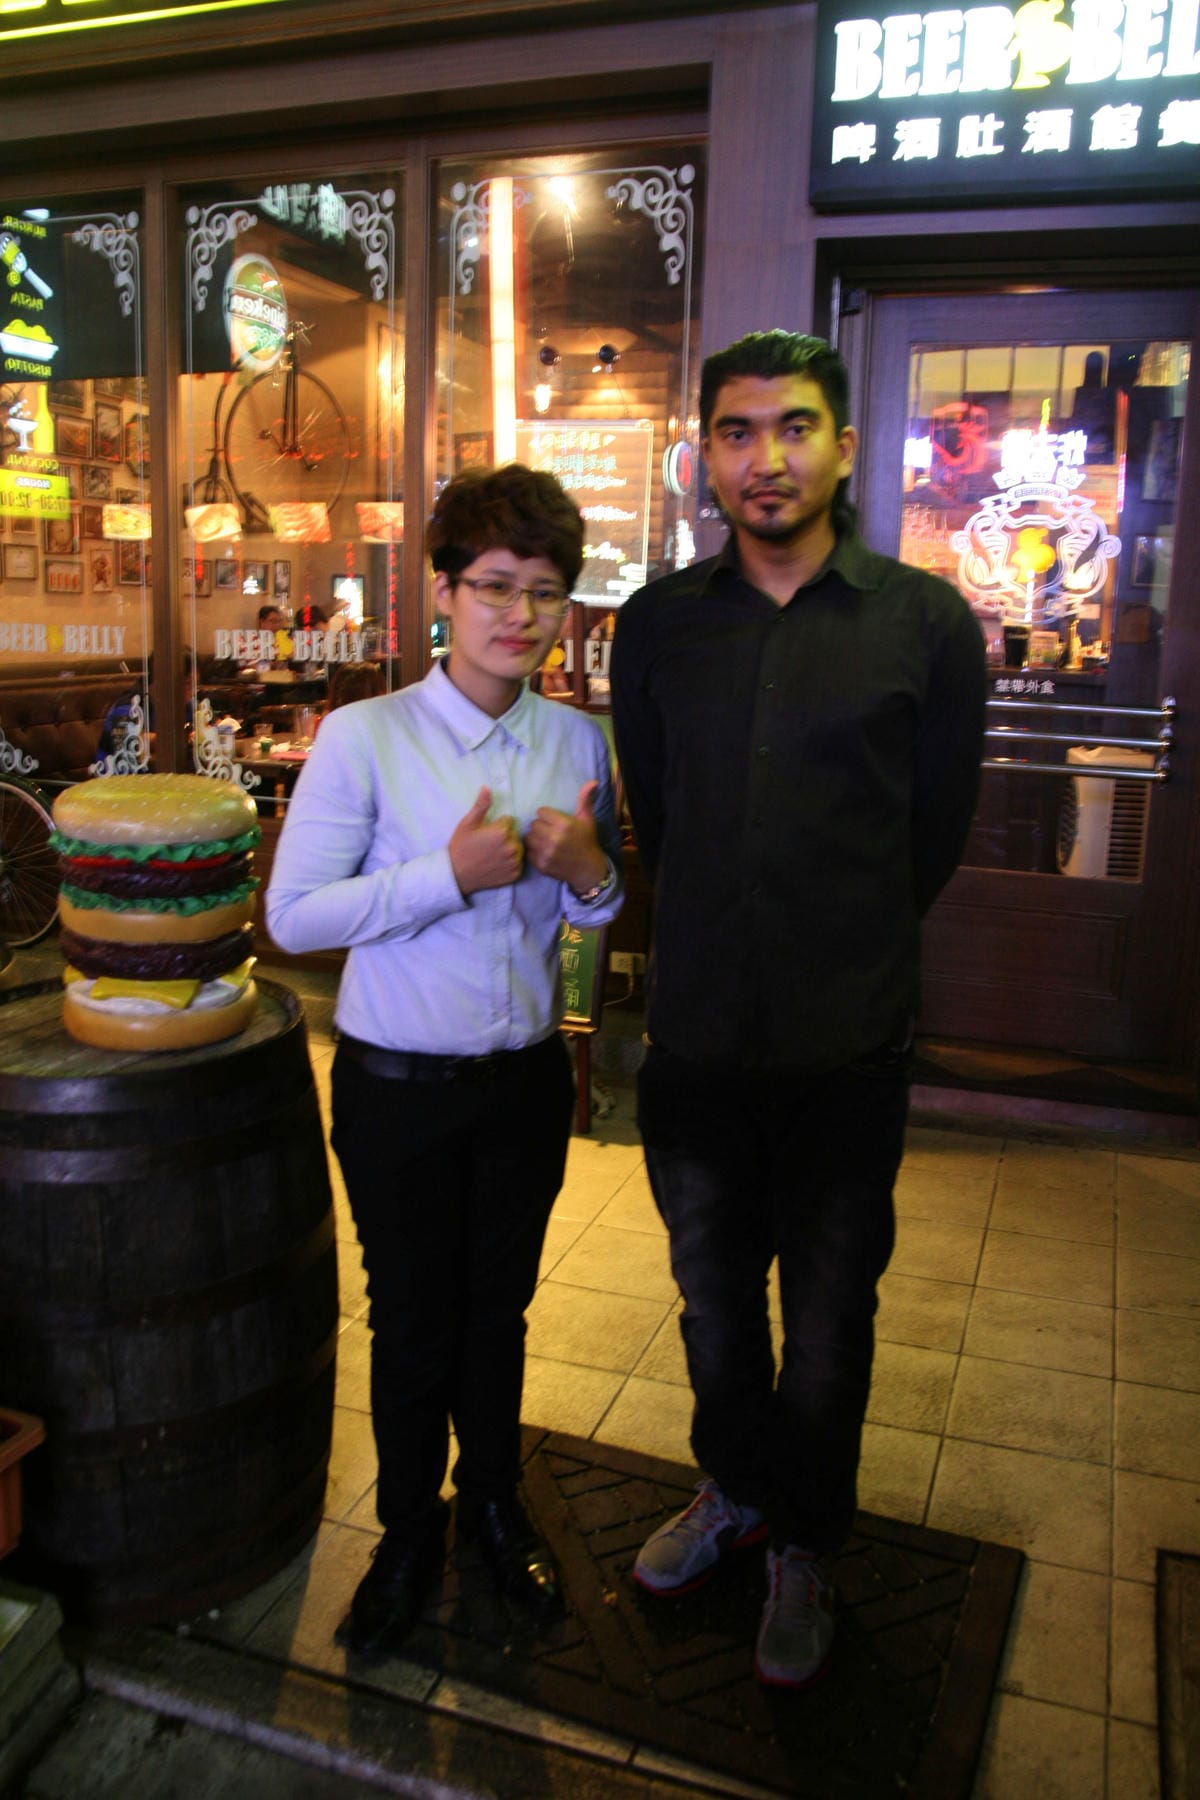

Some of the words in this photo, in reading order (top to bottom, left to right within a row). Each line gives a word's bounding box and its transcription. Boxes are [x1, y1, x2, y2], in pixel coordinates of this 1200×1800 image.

[832, 5, 1014, 101] BEER
[0, 623, 48, 653] BEER
[63, 625, 127, 655] BELLY
[215, 629, 276, 661] BEER
[294, 630, 367, 663] BELLY
